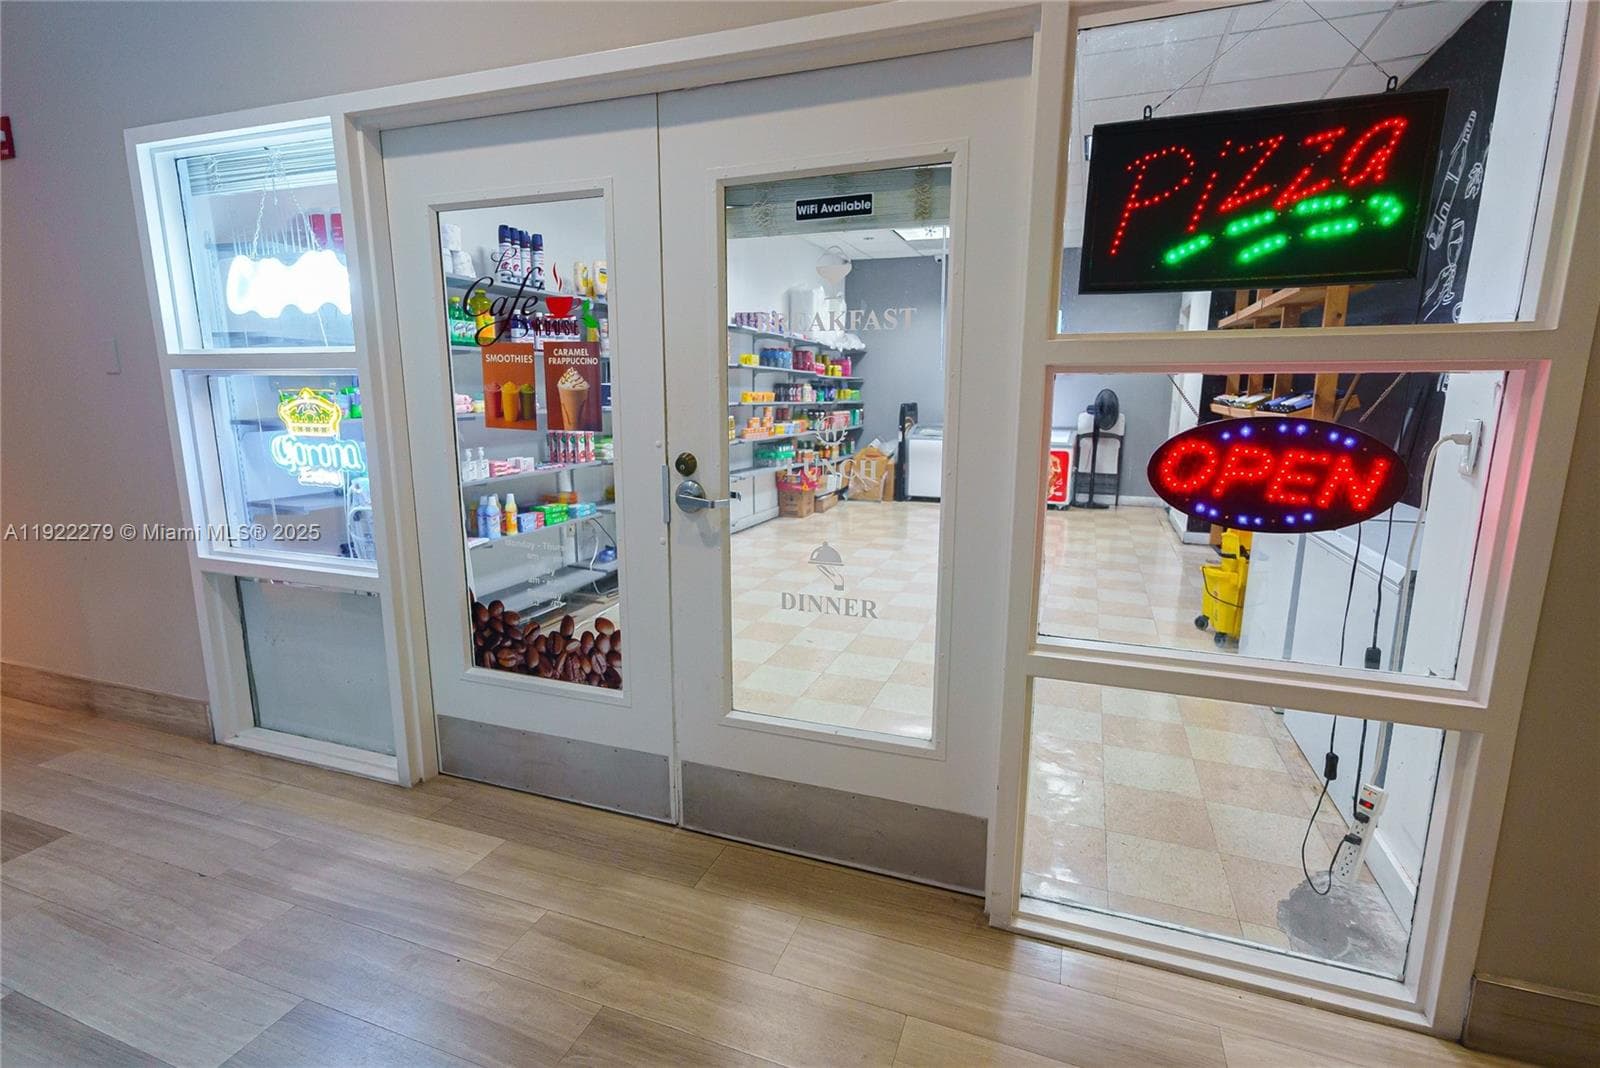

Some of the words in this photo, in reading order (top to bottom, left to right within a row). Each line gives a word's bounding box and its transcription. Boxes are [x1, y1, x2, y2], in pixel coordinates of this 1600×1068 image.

[1109, 115, 1409, 256] Pizza
[796, 203, 818, 216] WiFi
[820, 199, 872, 213] Available
[462, 266, 542, 347] Café
[485, 353, 534, 364] SMOOTHIES
[548, 356, 599, 366] FRAPPUCCINO
[552, 348, 589, 357] CARAMEL
[271, 435, 362, 472] Corona
[786, 457, 880, 481] LUNCH
[1158, 438, 1391, 511] OPEN
[780, 592, 880, 620] DINNER
